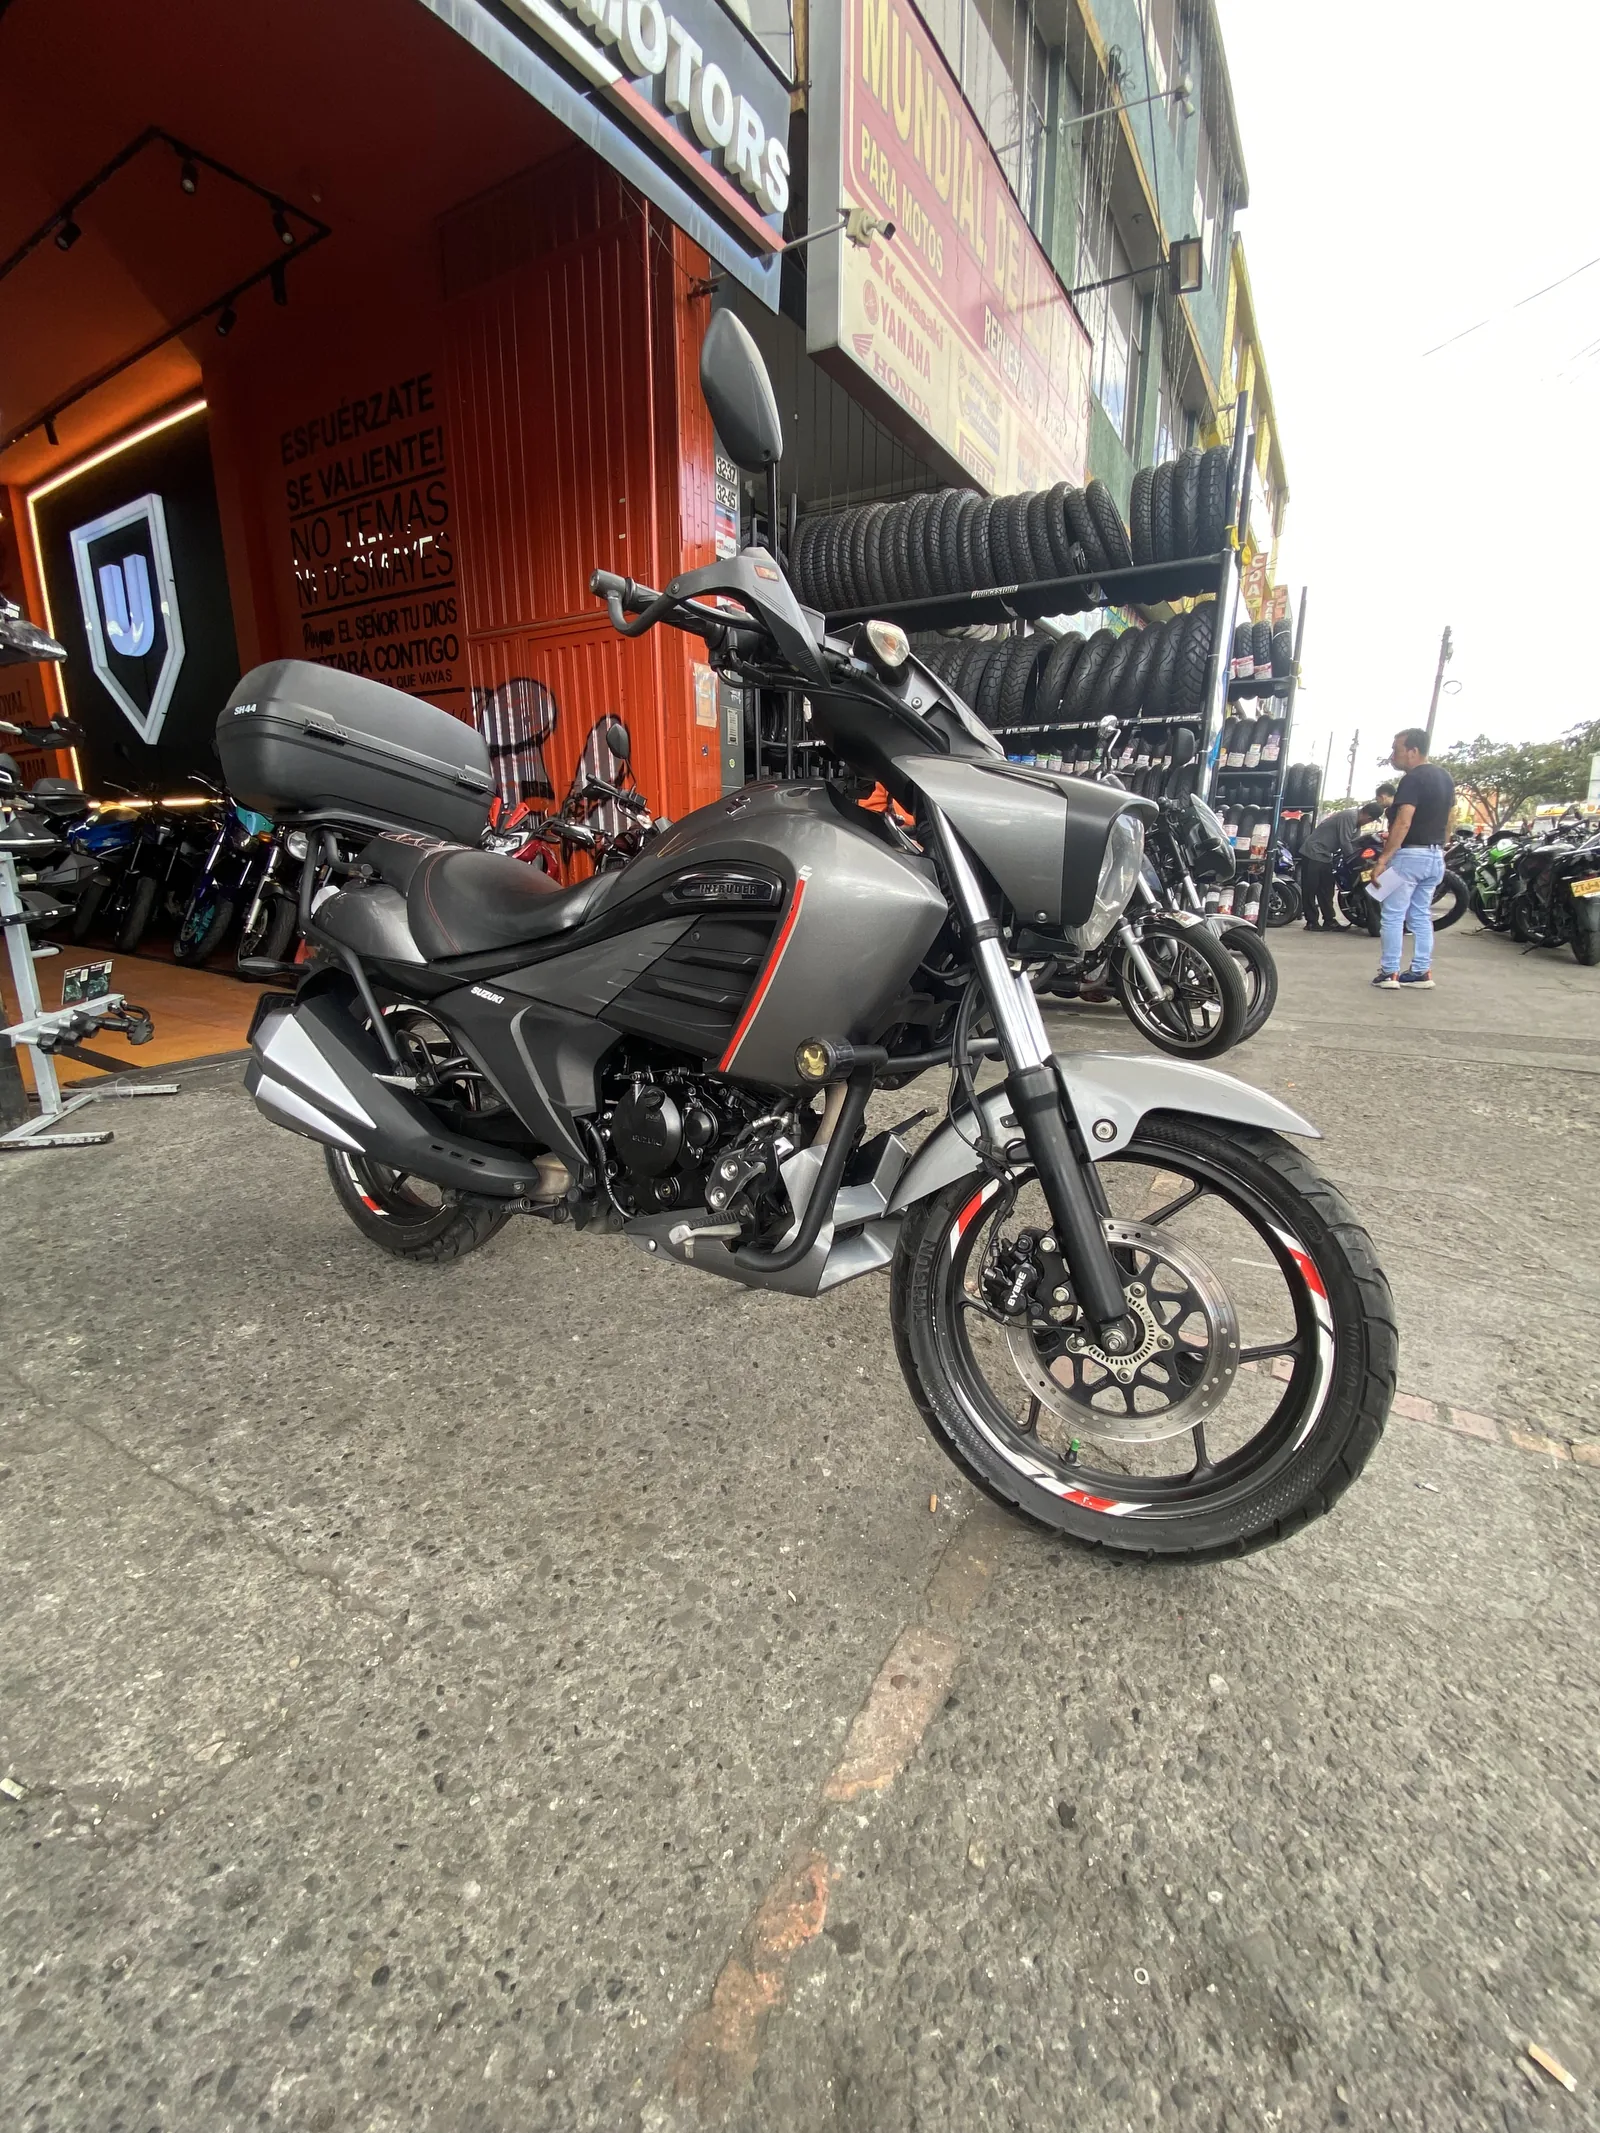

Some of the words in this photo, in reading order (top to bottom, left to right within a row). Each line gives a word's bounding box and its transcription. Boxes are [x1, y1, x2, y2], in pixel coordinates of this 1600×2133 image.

[861, 0, 987, 267] MUNDIAL
[994, 193, 1020, 317] DE
[861, 122, 898, 218] PARA
[902, 184, 944, 280] MOTOS
[881, 295, 931, 385] YAMAHA
[885, 256, 943, 352] Kawasaki
[281, 372, 434, 467] ESFUÉRZATE
[872, 350, 932, 428] HONDA
[286, 473, 315, 512] SE
[318, 426, 445, 499] VALIENTE!
[289, 516, 332, 566] NO
[338, 480, 449, 549] TEMAS
[98, 553, 155, 657] U
[295, 569, 318, 608] NI
[324, 532, 454, 601] DESMAYES
[307, 641, 371, 675] TARÁ
[374, 633, 459, 673] CONTIGO
[338, 619, 353, 644] EL
[355, 606, 400, 641] SEÑOR
[402, 604, 420, 633] TU
[423, 597, 458, 628] DIOS
[234, 704, 257, 715] SH44
[396, 674, 416, 690] QUE
[419, 669, 453, 685] VAYAS
[700, 883, 758, 896] INTRUDER
[470, 986, 505, 1004] SUZUKI
[1007, 1271, 1028, 1307] BYBRE
